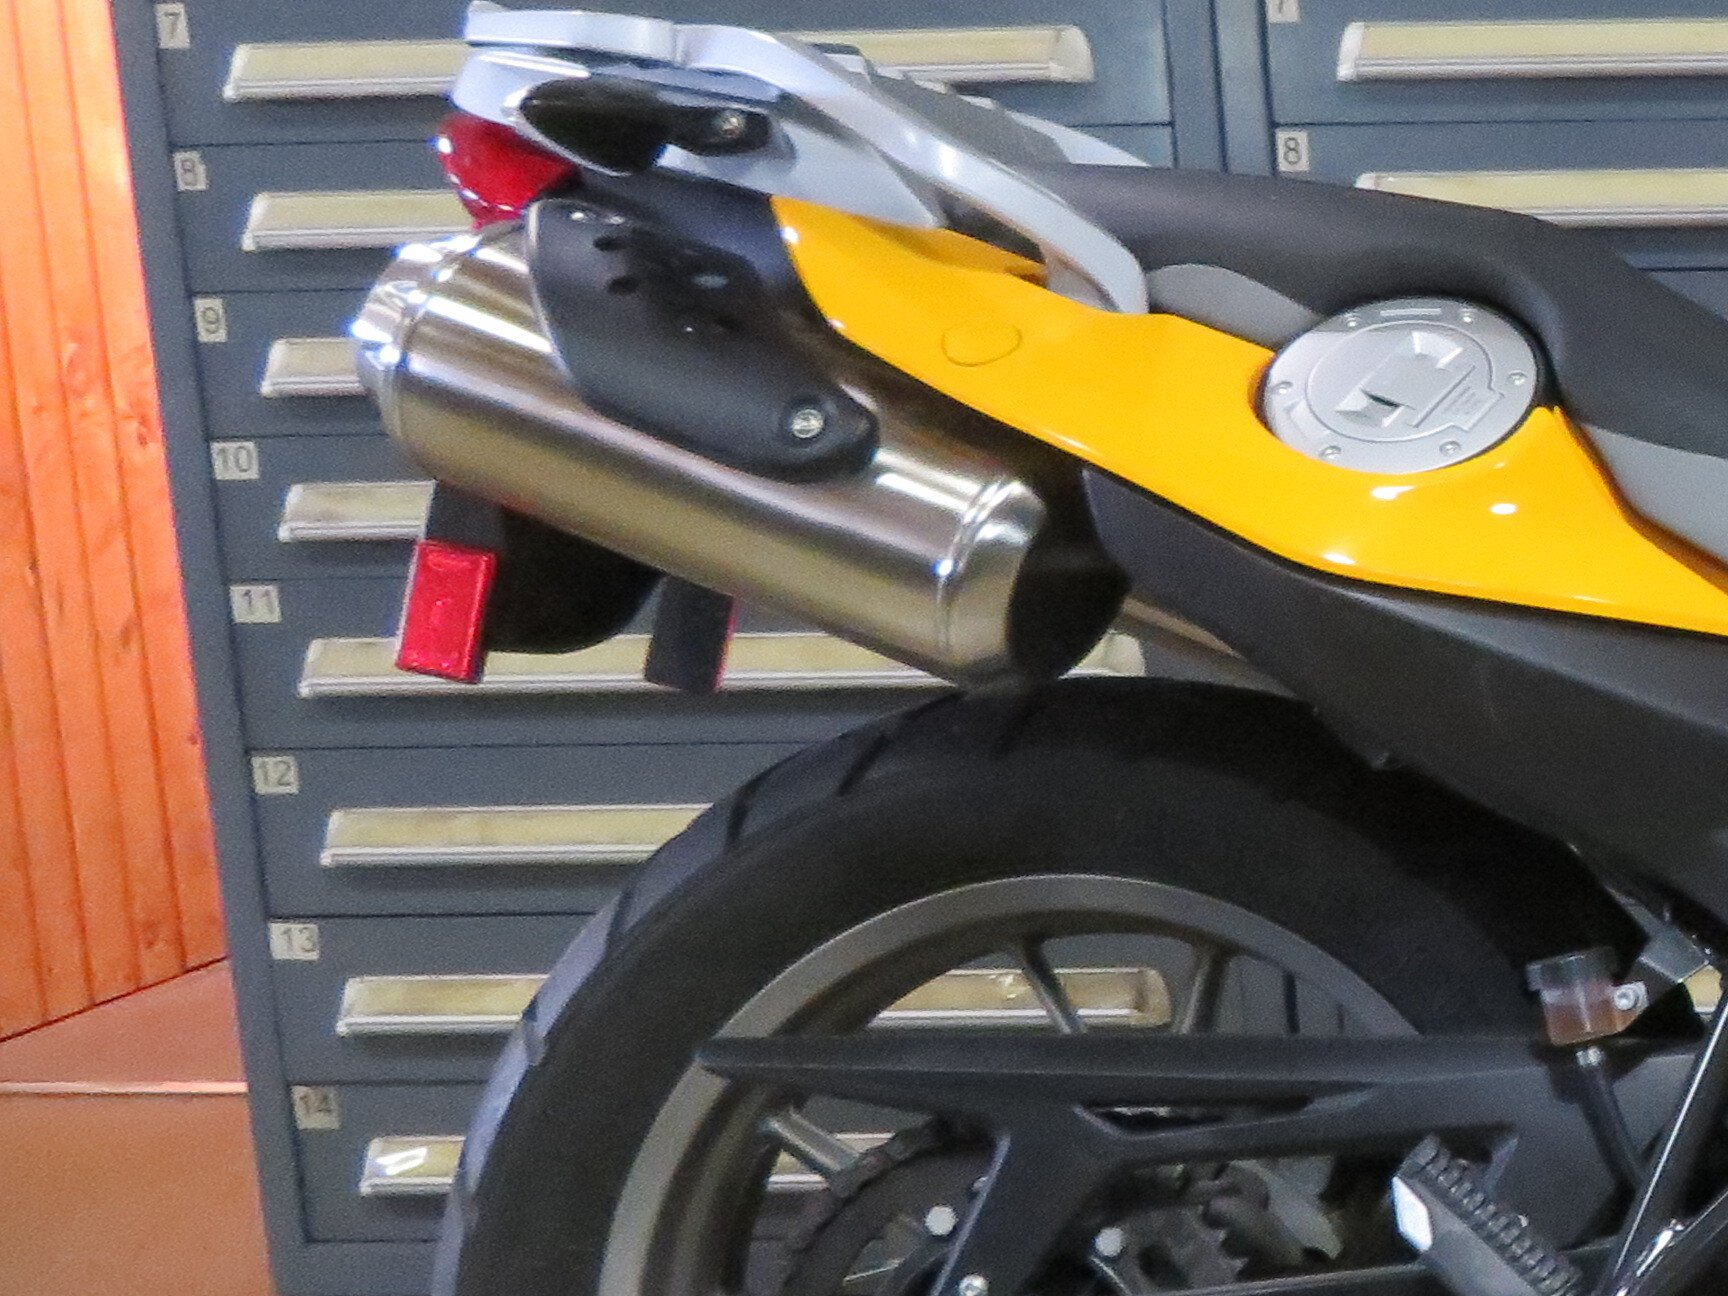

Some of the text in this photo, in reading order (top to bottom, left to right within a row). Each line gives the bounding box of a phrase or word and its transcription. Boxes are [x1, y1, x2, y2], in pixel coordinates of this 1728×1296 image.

[163, 11, 182, 41] 7
[1283, 137, 1302, 166] 8
[203, 306, 222, 335] 9
[218, 446, 251, 473] 10
[259, 760, 292, 787] 12
[281, 929, 318, 952] 13
